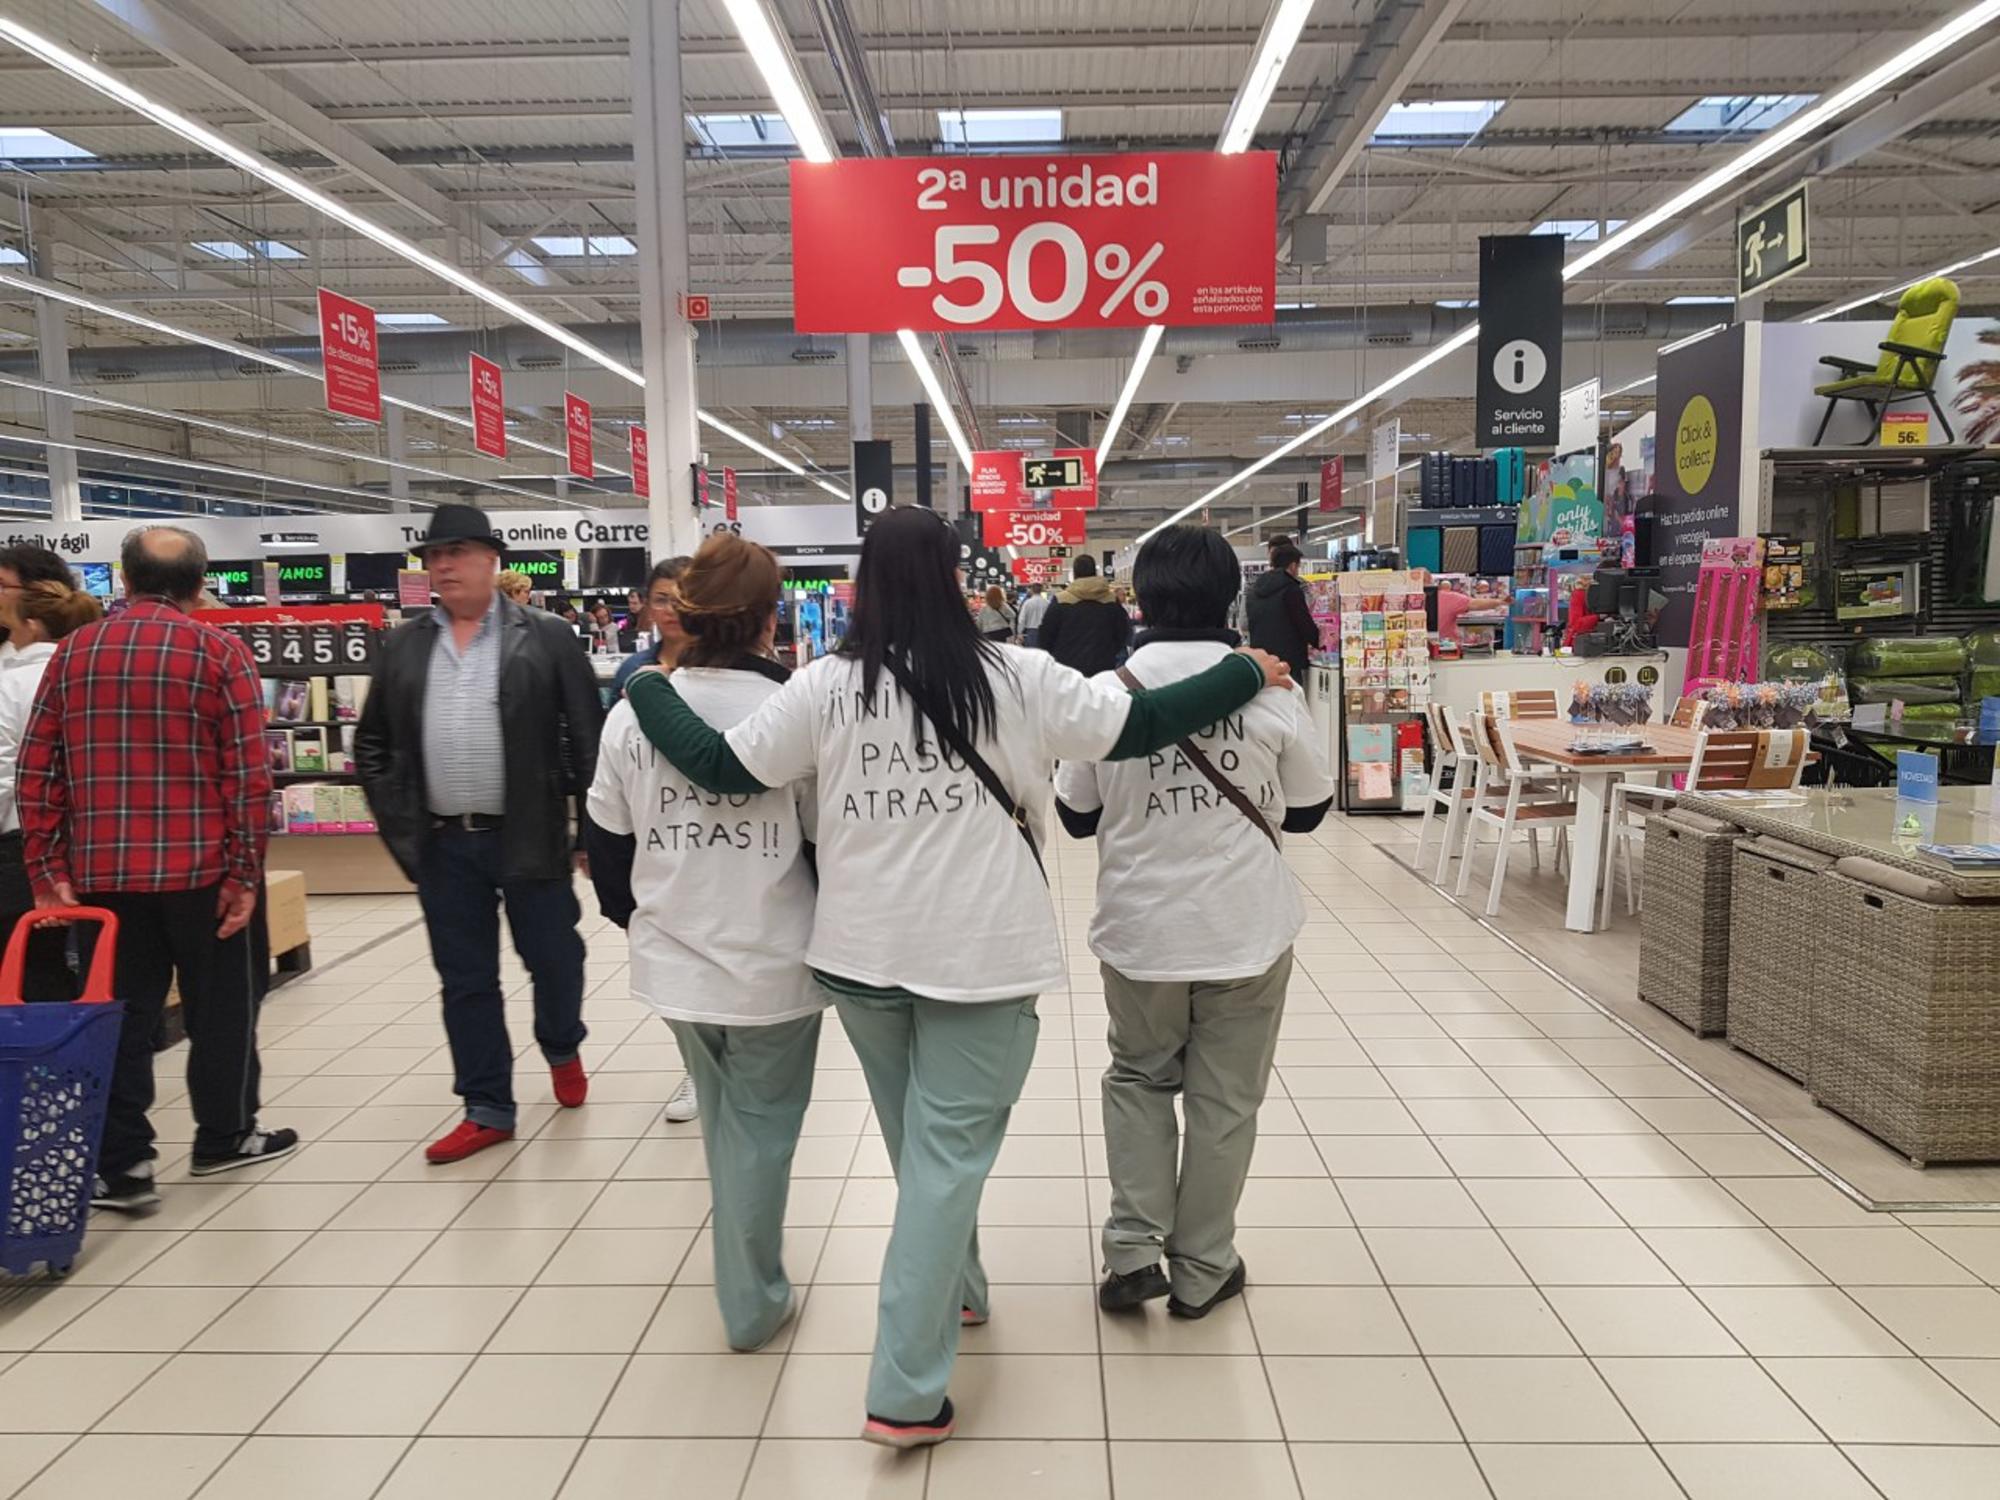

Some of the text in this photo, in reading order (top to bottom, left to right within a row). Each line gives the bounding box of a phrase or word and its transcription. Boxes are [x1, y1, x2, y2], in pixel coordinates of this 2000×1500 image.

[917, 162, 1158, 210] 2ª unidad
[897, 221, 1170, 324] -50%
[1196, 287, 1208, 295] en
[1209, 285, 1223, 295] los
[1246, 295, 1263, 303] con
[1193, 303, 1263, 315] esta promoción
[330, 312, 371, 352] -15%
[477, 370, 500, 400] -15%
[1494, 407, 1543, 421] Servicio
[1491, 422, 1545, 435] al cliente
[1679, 449, 1711, 470] collect
[1022, 511, 1061, 521] unidad
[1706, 504, 1728, 520] online
[60, 533, 90, 554] ágil
[508, 524, 567, 541] online
[1005, 523, 1064, 546] -50%
[253, 639, 272, 664] 3
[283, 640, 303, 664] 4
[313, 640, 333, 663] 5
[346, 637, 367, 662] 6
[1149, 749, 1239, 780] PAO
